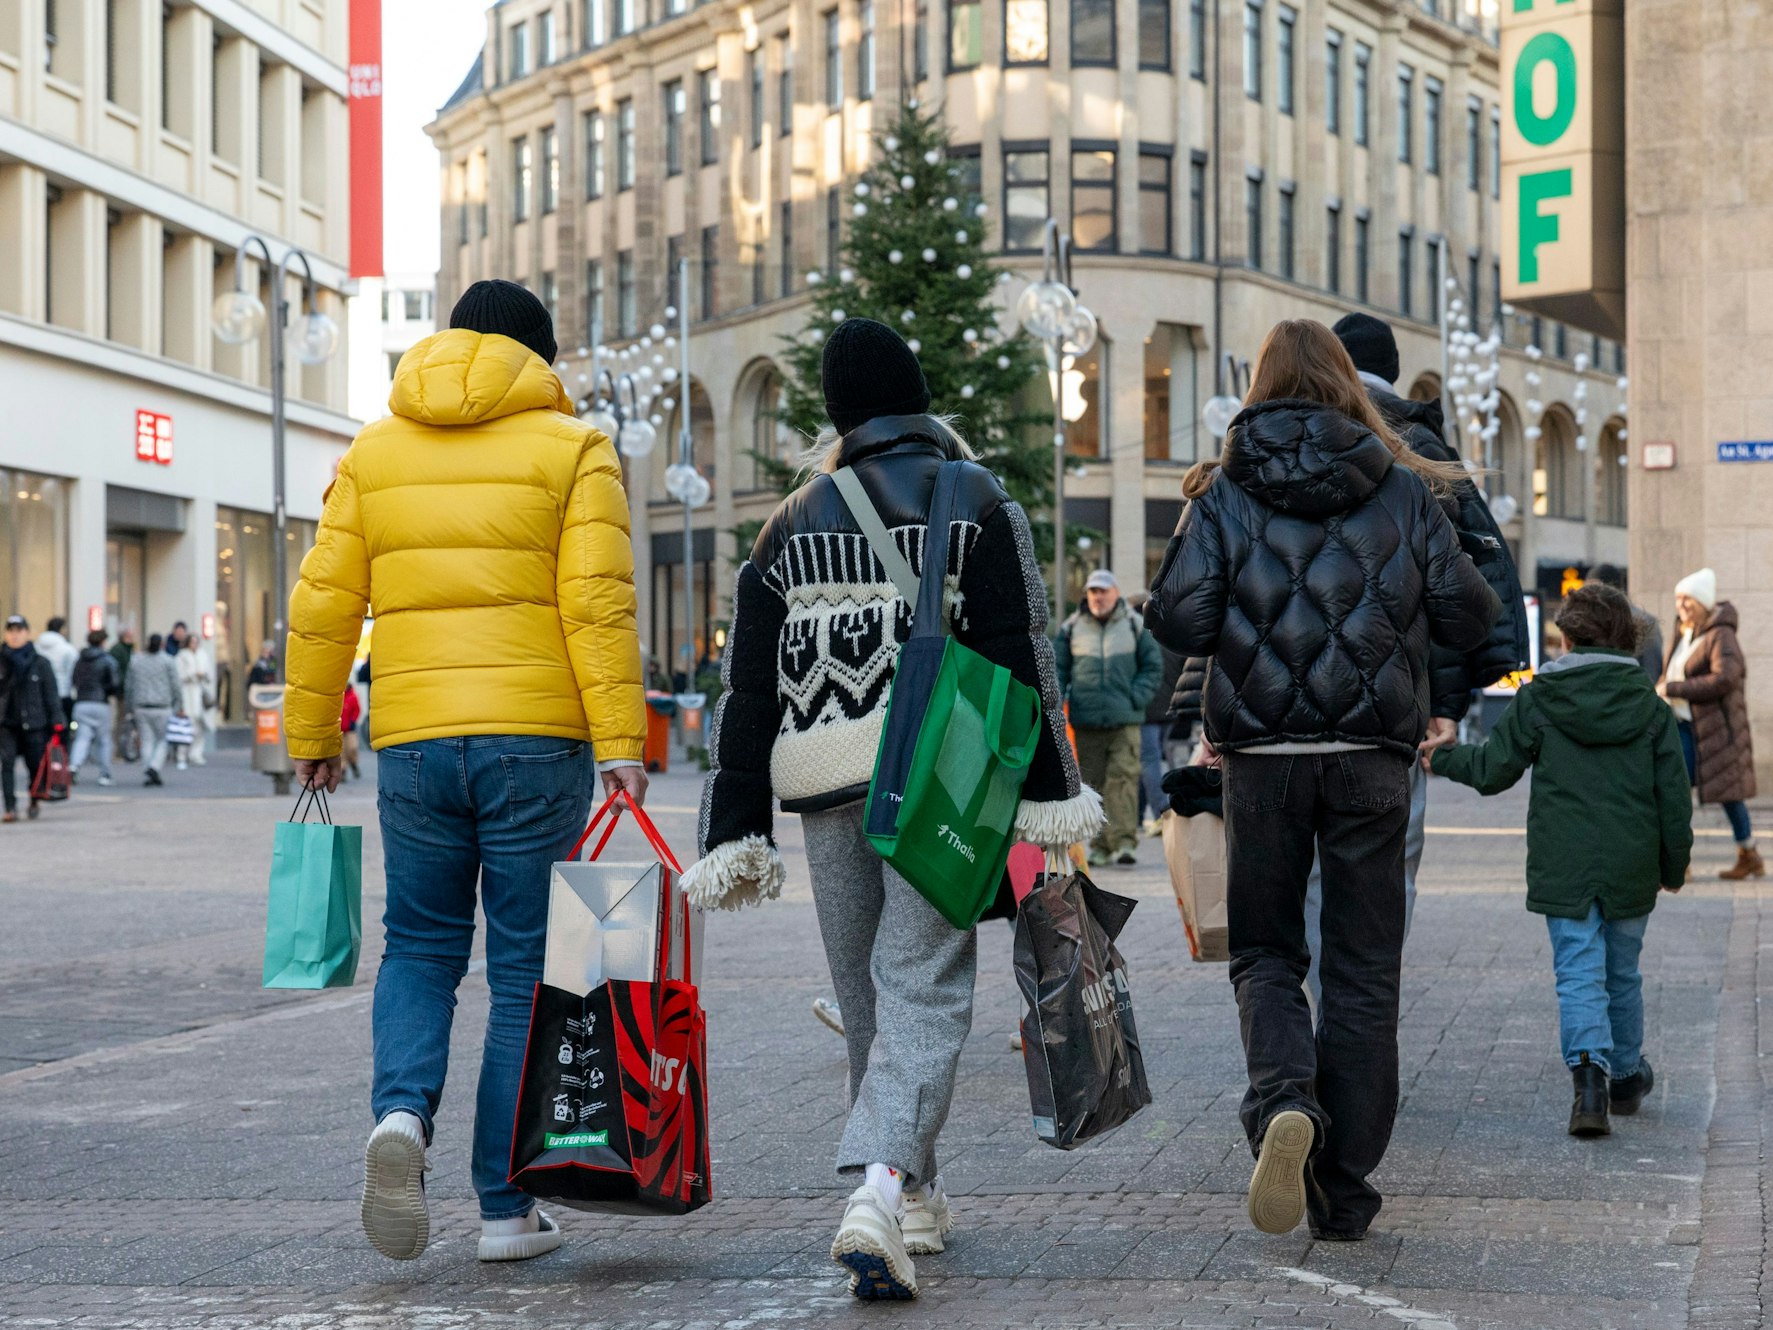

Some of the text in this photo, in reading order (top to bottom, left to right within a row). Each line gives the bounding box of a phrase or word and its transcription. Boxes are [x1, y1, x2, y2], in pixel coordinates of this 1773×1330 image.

[1513, 0, 1577, 285] OF
[948, 831, 976, 864] Thalia
[548, 1133, 606, 1146] BETTER WAY
